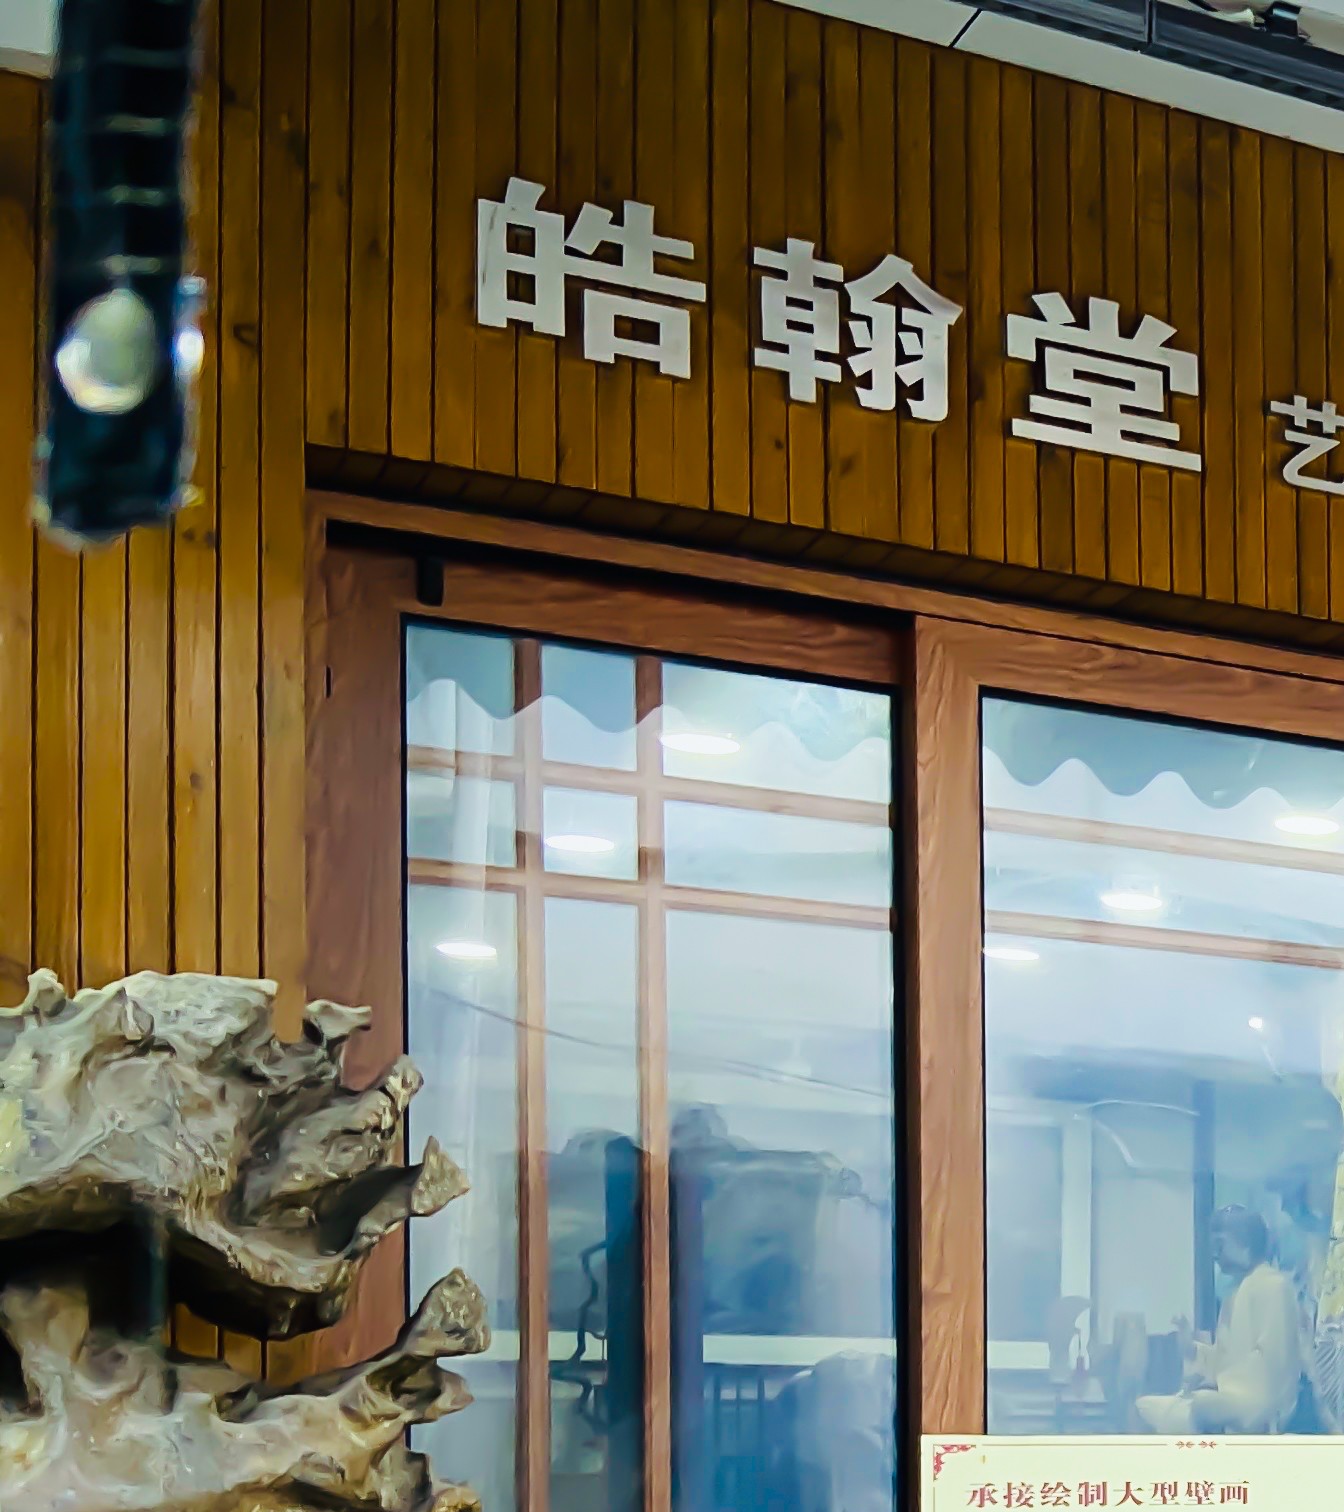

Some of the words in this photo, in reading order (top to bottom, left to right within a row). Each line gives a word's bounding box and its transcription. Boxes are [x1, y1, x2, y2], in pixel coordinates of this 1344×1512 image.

[477, 177, 1203, 473] 皓翰堂
[965, 1480, 1250, 1509] 承接绘制大型壁画
